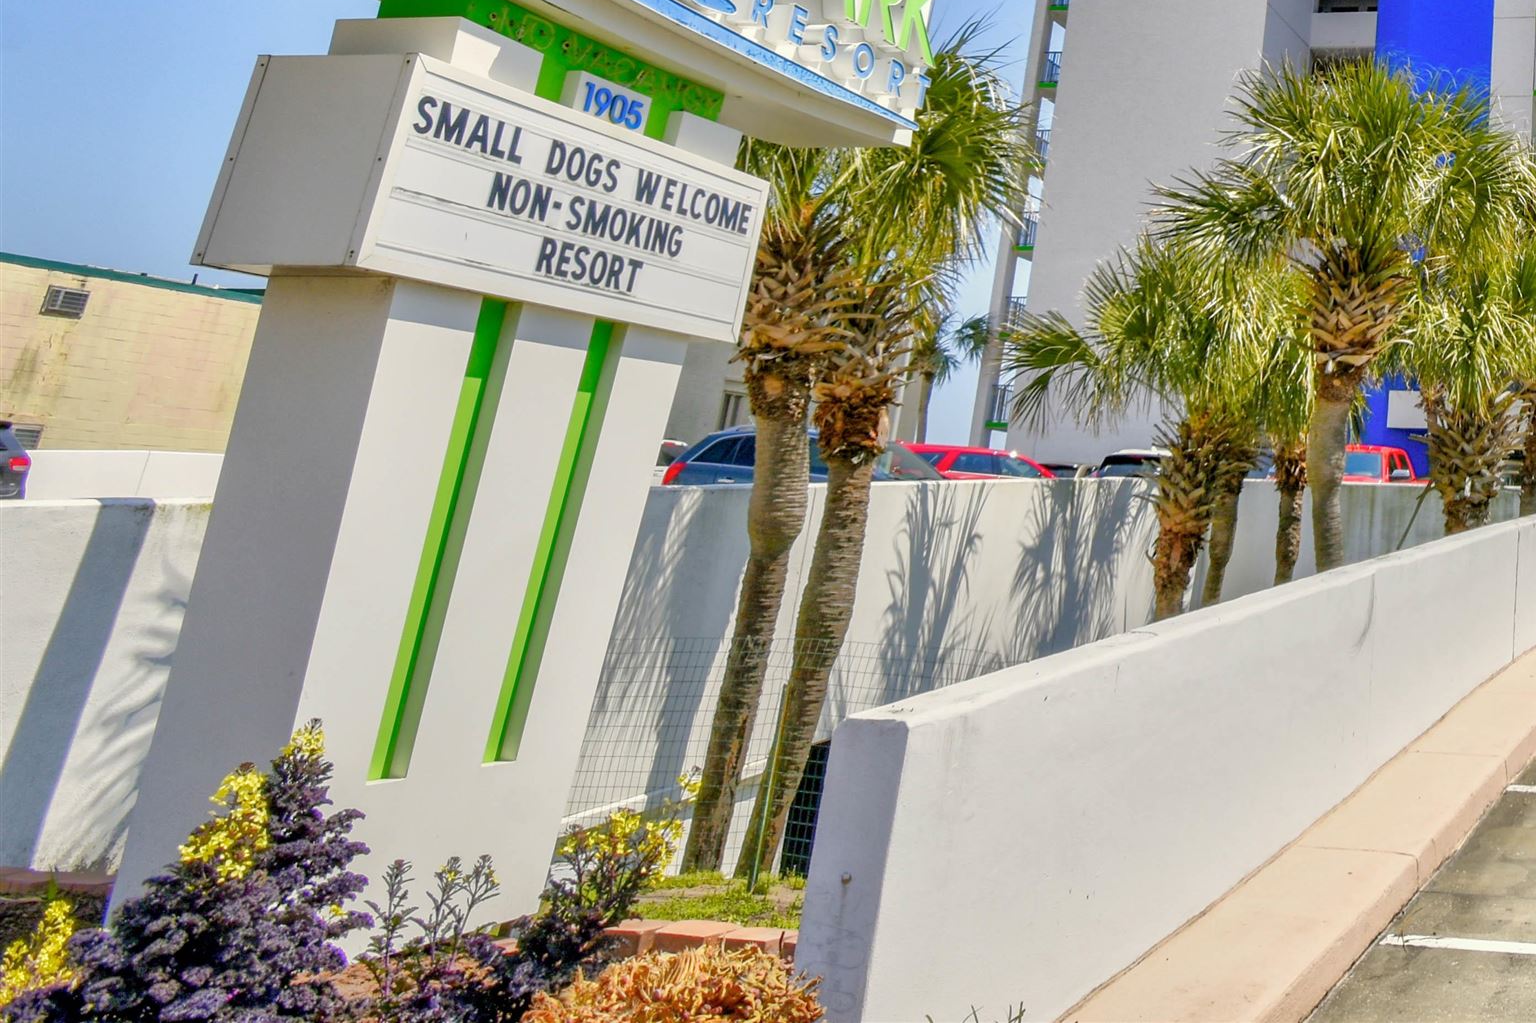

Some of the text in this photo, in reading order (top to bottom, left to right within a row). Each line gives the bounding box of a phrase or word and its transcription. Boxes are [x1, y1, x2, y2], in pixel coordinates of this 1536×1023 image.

[495, 7, 723, 113] NO VACANCY
[583, 81, 644, 130] 1905
[412, 95, 753, 235] SMALL DOGS WELCOME
[486, 172, 684, 258] NON-SMOKING
[535, 236, 646, 293] RESORT
